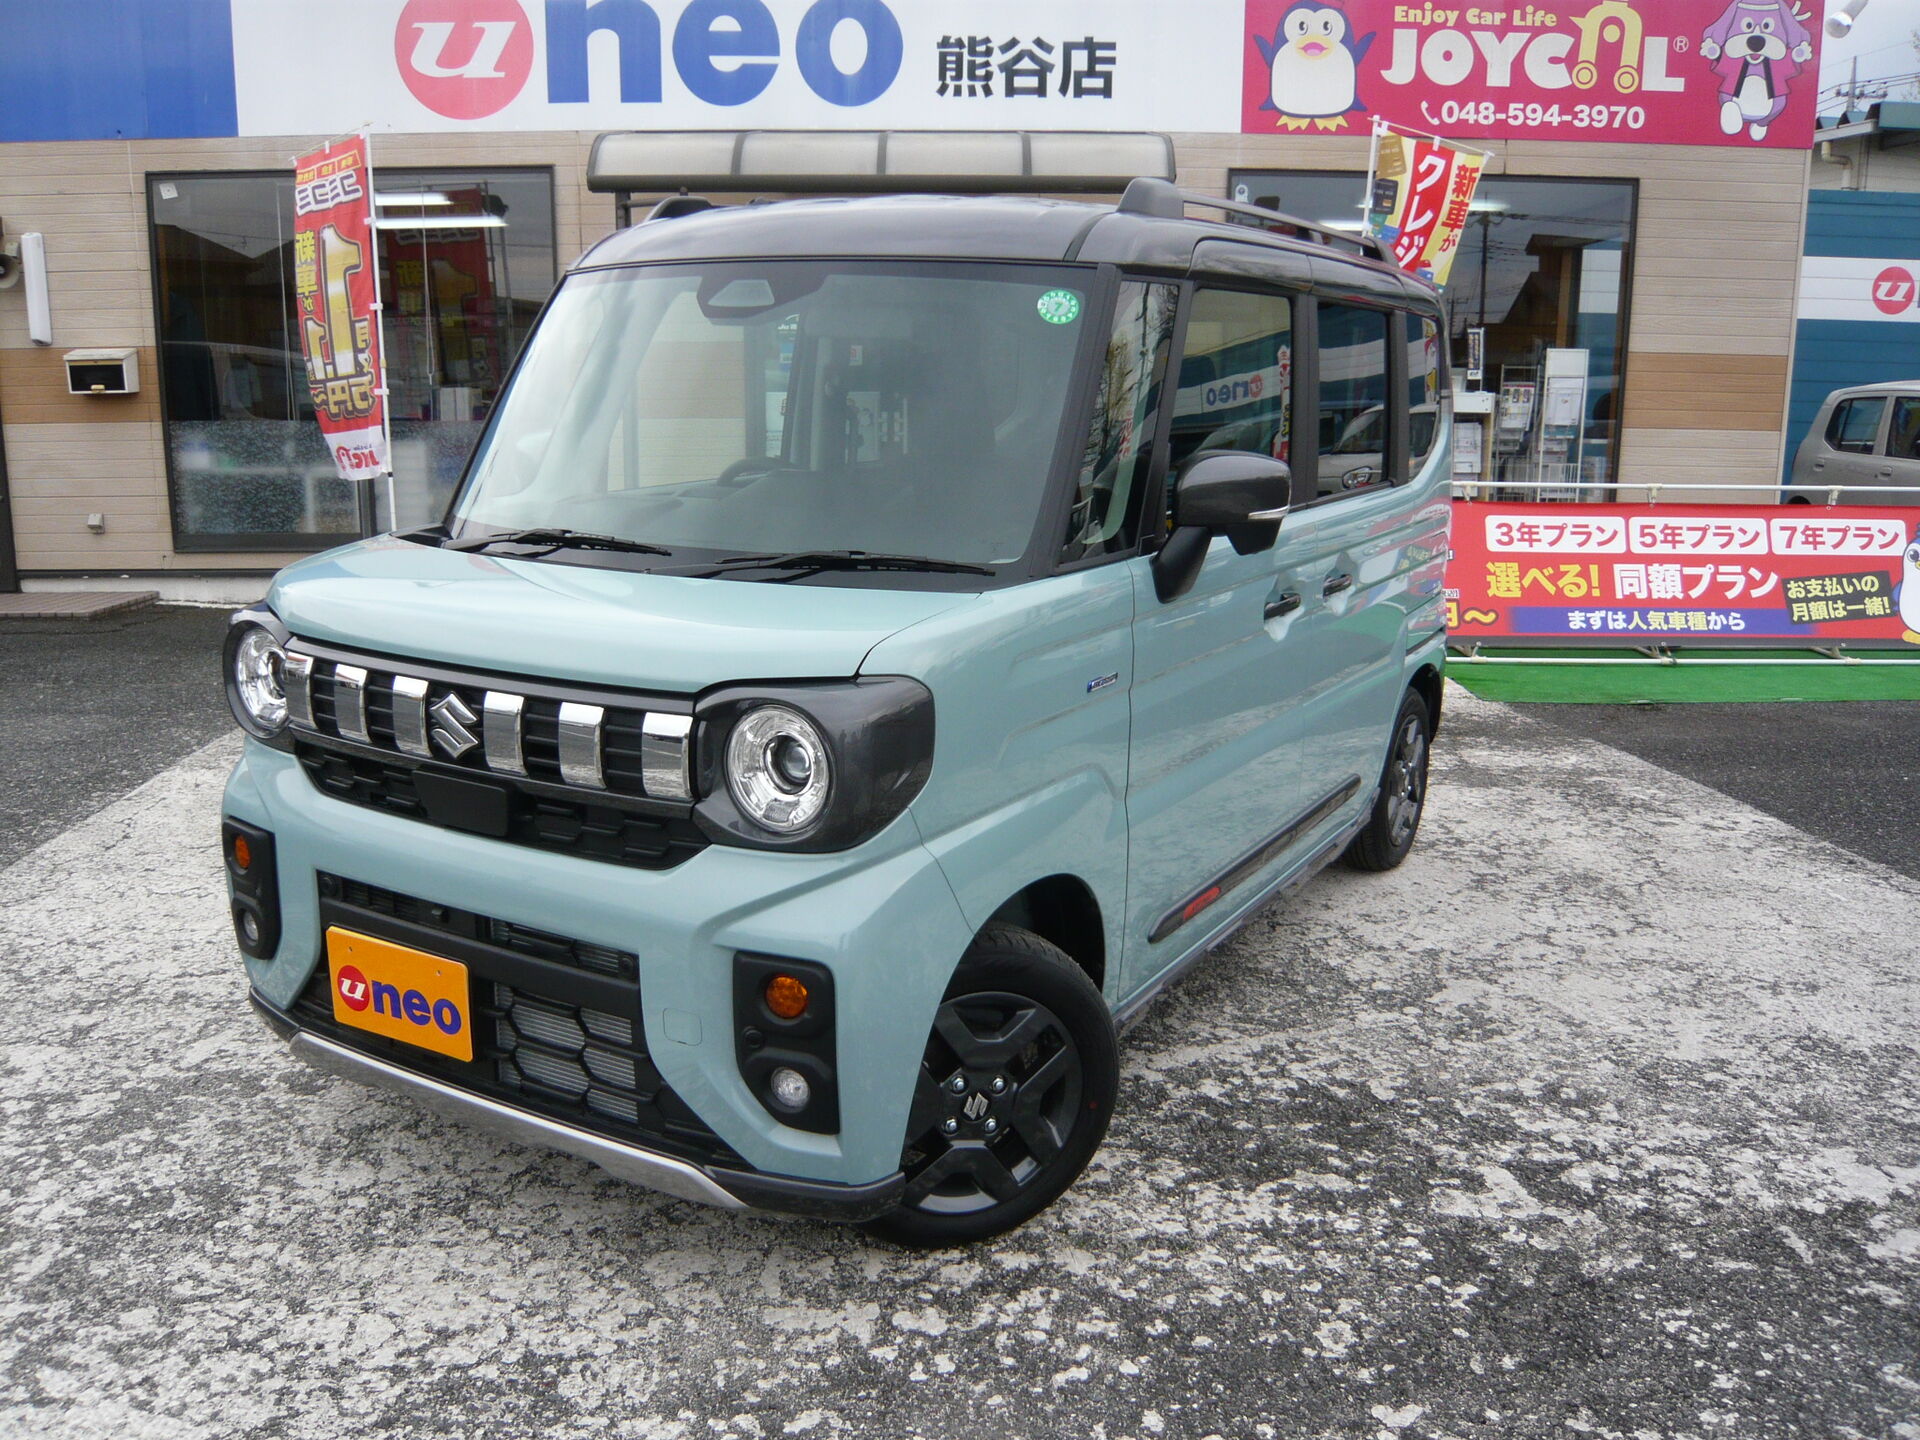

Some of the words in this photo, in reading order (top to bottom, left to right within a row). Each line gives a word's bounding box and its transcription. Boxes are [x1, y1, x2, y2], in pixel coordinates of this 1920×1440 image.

[1394, 1, 1459, 27] Enjoy
[1466, 8, 1507, 26] Car
[1513, 4, 1557, 27] Life
[397, 0, 904, 107] uneo
[1380, 0, 1685, 93] JOYCAL
[935, 36, 1117, 99] 熊谷店
[1441, 100, 1646, 129] 048-594-3970
[1438, 164, 1481, 253] 新車が
[1495, 522, 1619, 549] 3年プラン
[1639, 523, 1760, 550] 5年プラン
[1779, 525, 1900, 551] 7年プラン
[1486, 561, 1601, 598] 選べる!
[1613, 562, 1778, 600] 同額プラン
[1787, 575, 1880, 600] お支払いの
[1567, 610, 1746, 631] まずは人気車種から
[340, 977, 462, 1035] uneo
